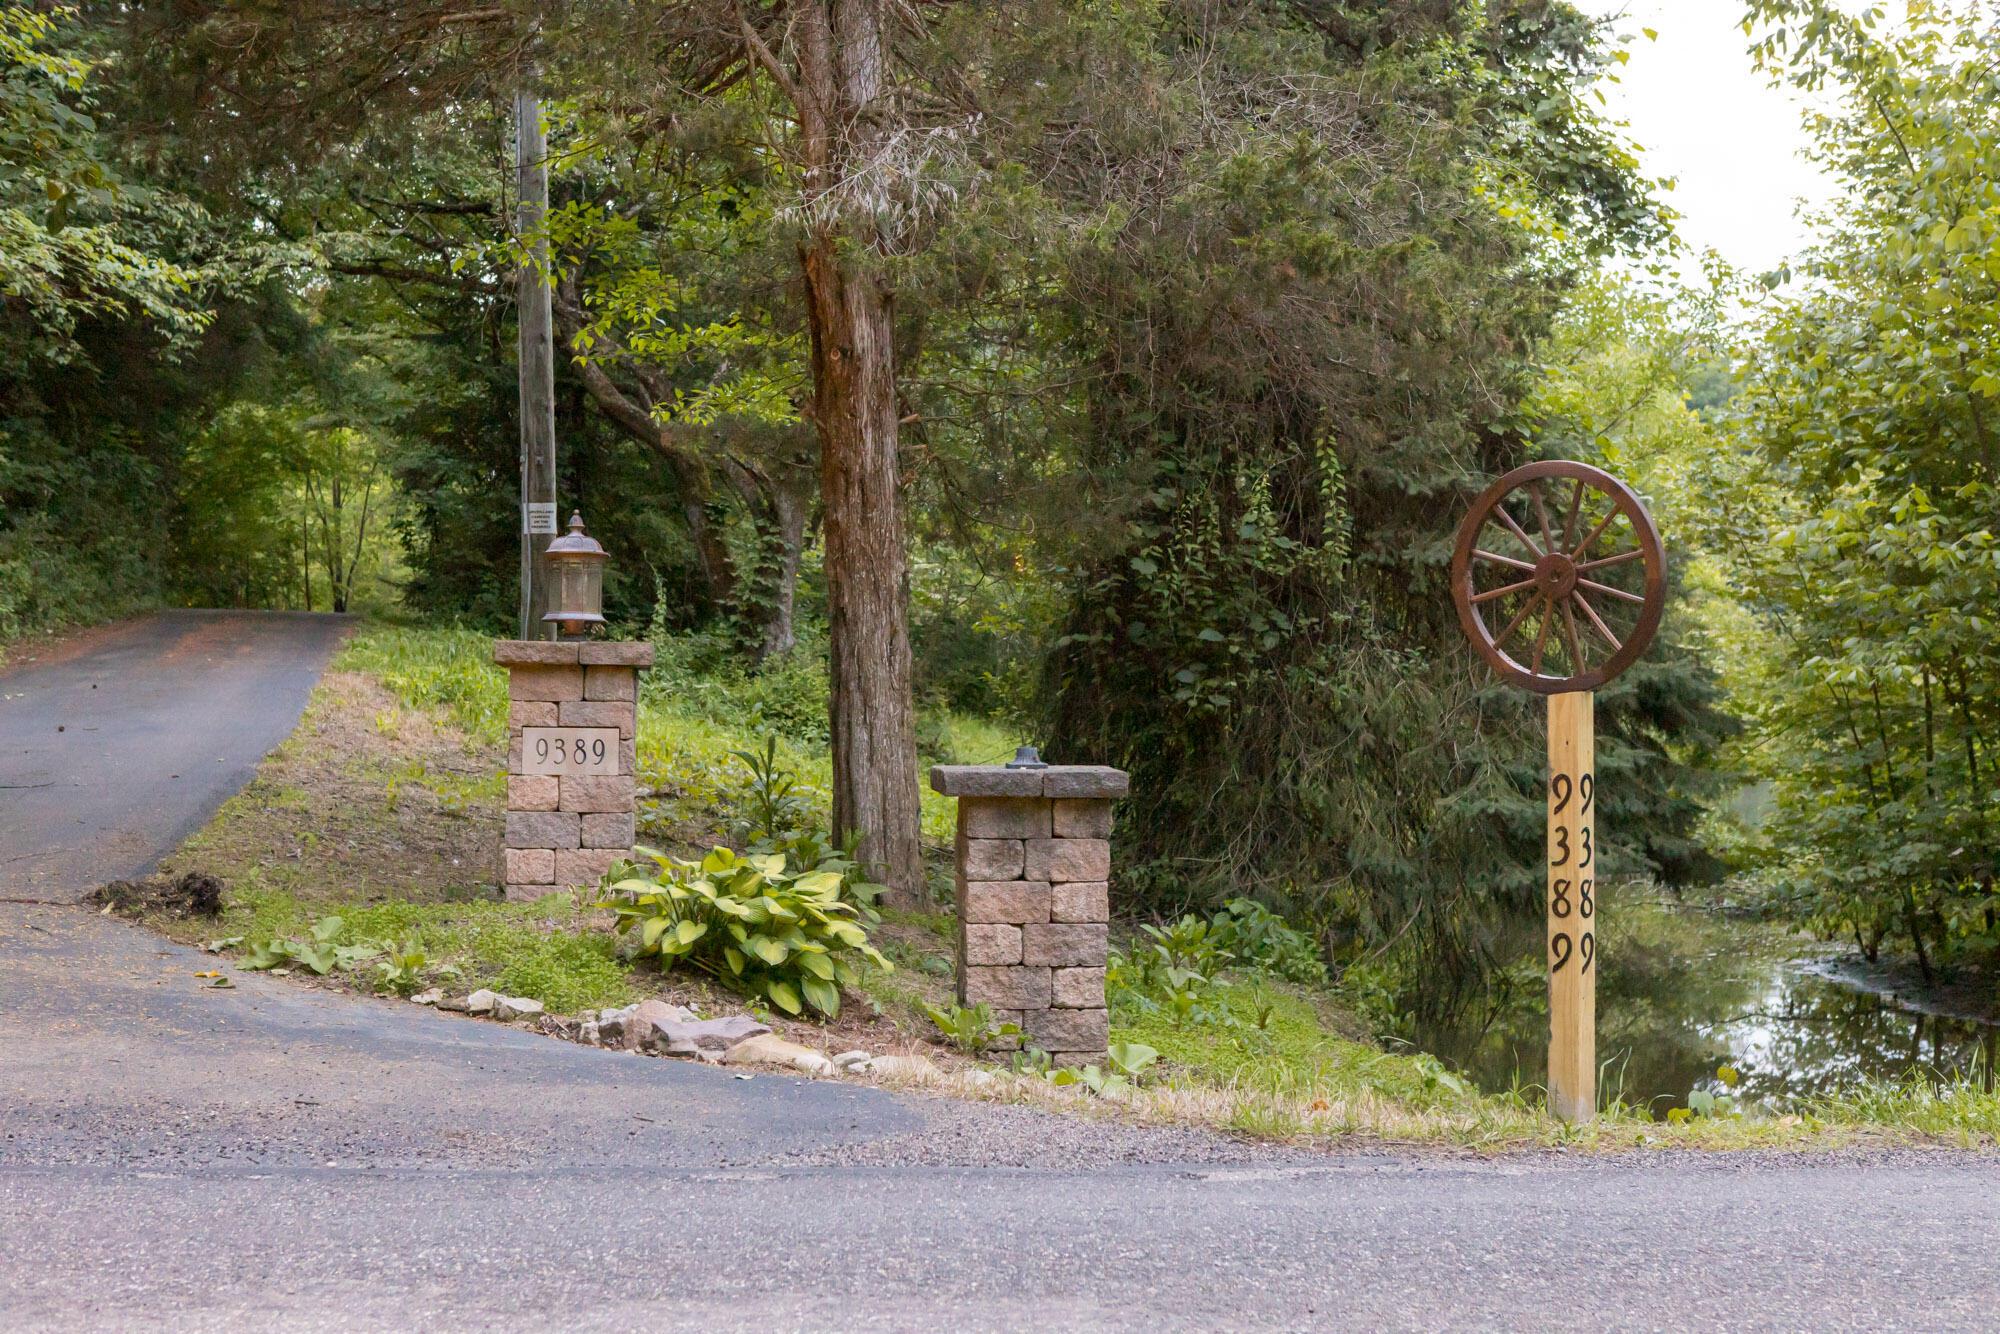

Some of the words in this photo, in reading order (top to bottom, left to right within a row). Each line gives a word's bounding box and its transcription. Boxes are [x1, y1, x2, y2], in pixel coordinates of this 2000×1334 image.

[536, 738, 605, 765] 9389
[1551, 773, 1573, 974] 9389
[1579, 773, 1595, 975] 9389
